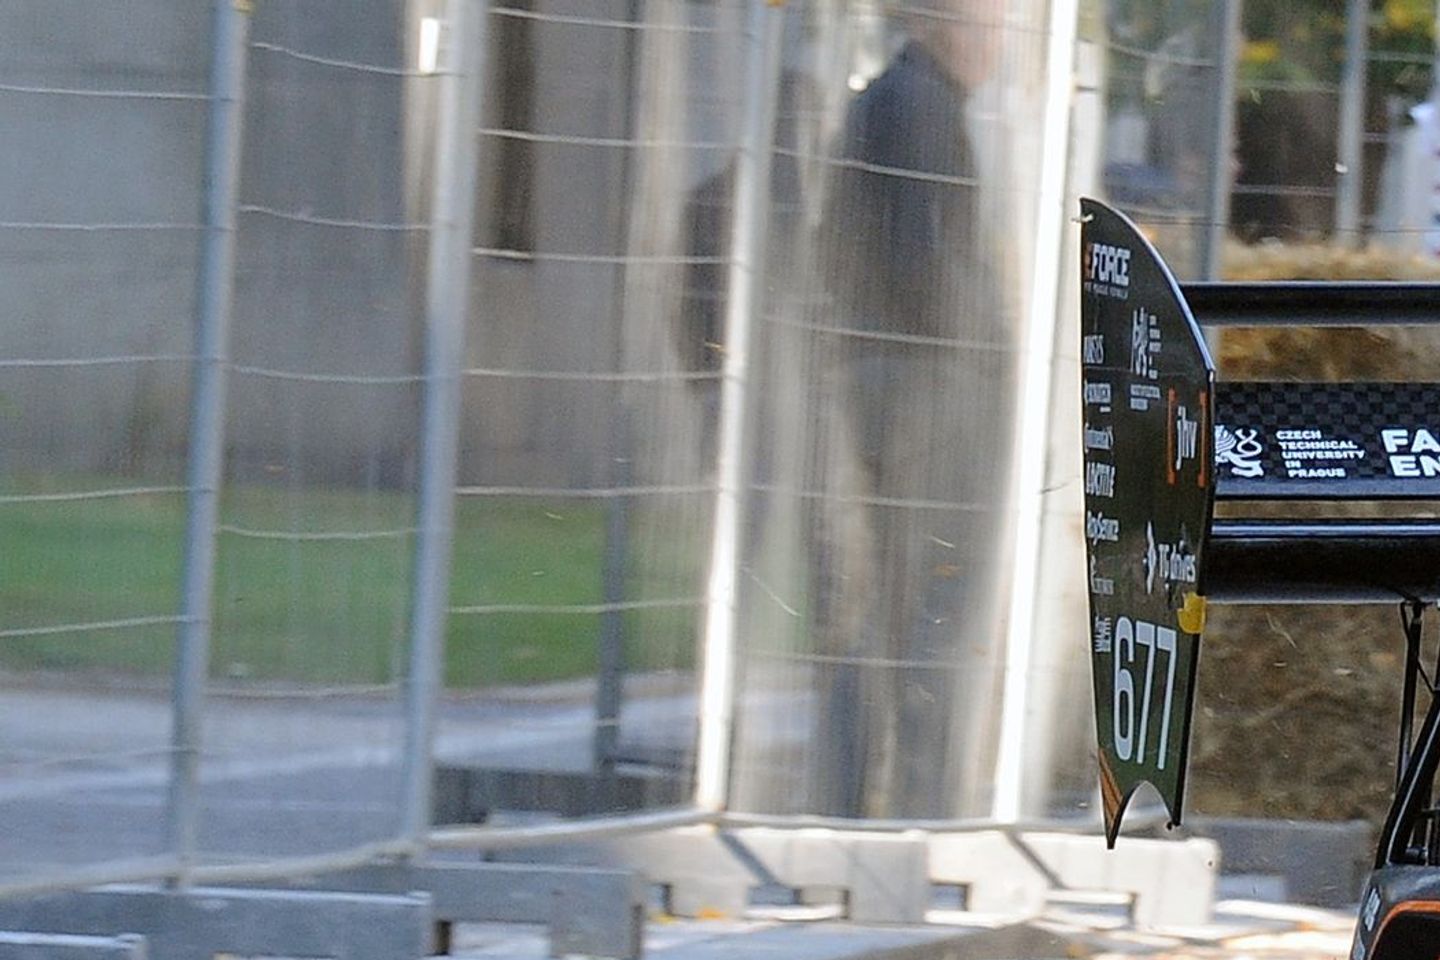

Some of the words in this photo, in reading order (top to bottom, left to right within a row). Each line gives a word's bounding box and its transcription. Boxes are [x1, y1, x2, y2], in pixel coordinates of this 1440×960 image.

[1276, 430, 1321, 440] CZECH
[1279, 440, 1358, 450] TECHNICAL
[1282, 450, 1365, 459] UNIVERSITY
[1285, 460, 1301, 468] IN
[1288, 468, 1346, 477] PRAGUE
[1113, 616, 1177, 770] 677
